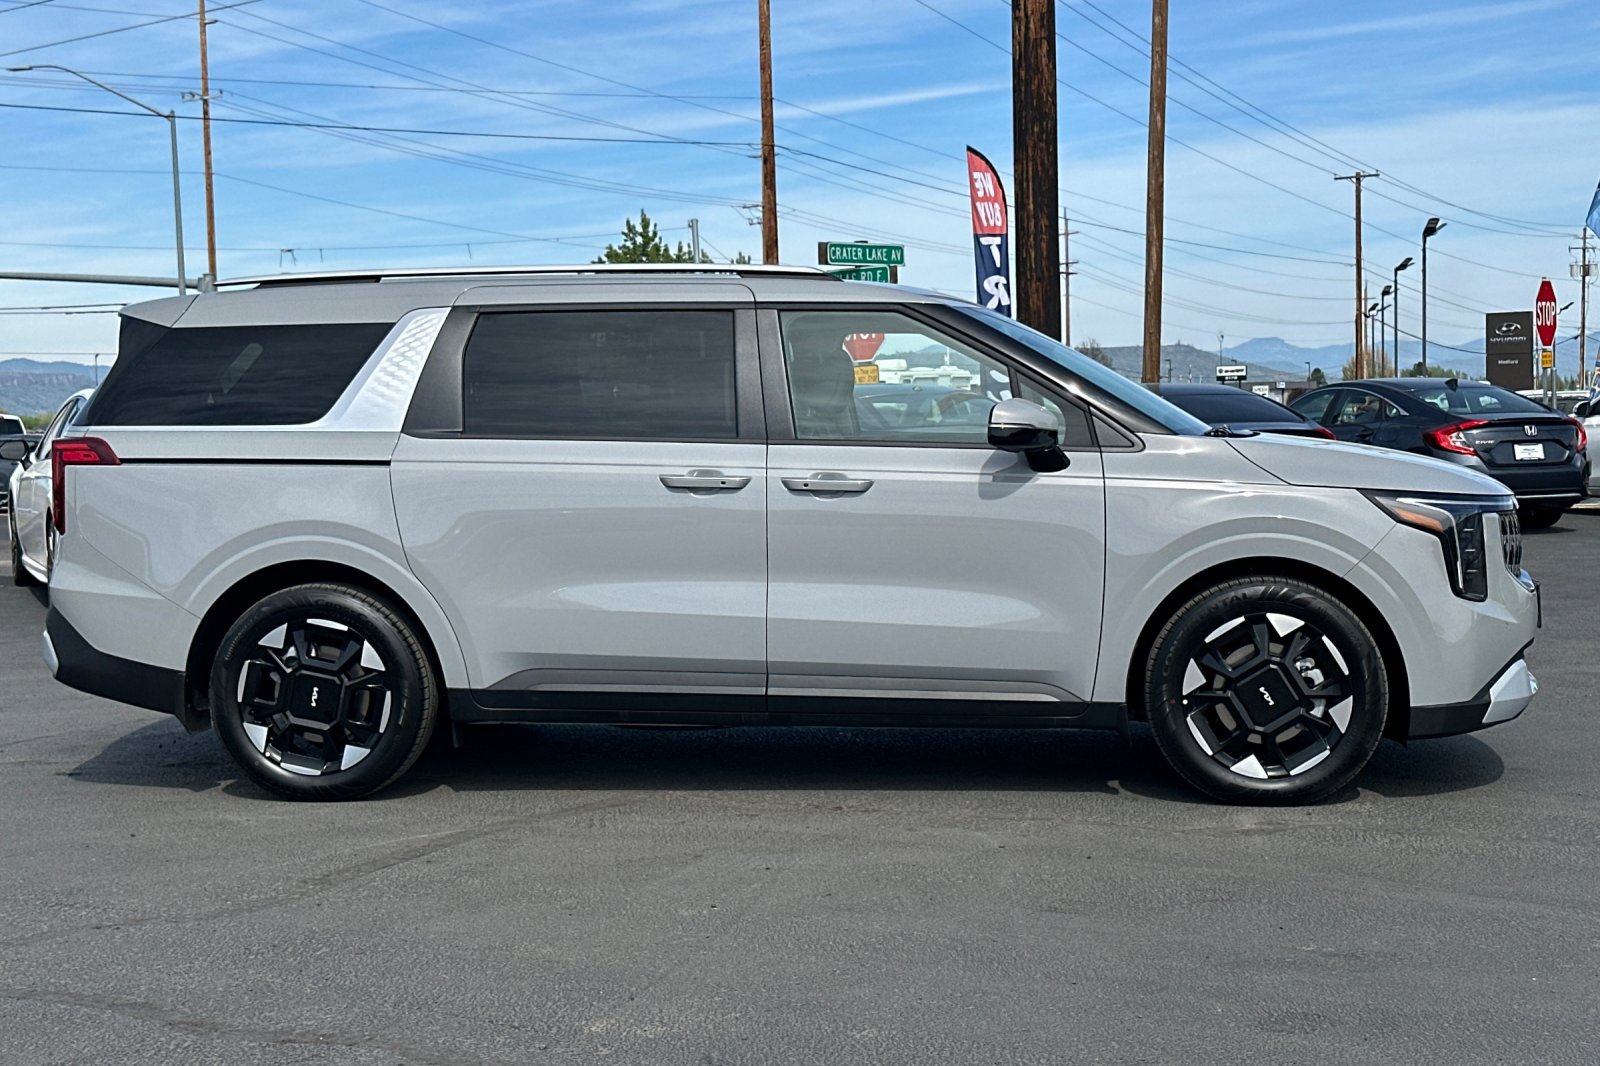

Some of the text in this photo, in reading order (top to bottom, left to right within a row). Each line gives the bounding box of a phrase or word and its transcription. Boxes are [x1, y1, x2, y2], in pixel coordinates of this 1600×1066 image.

[831, 247, 901, 261] CRATER LAKE AV
[1537, 301, 1556, 327] STOP
[1490, 336, 1526, 344] HYUNDAI
